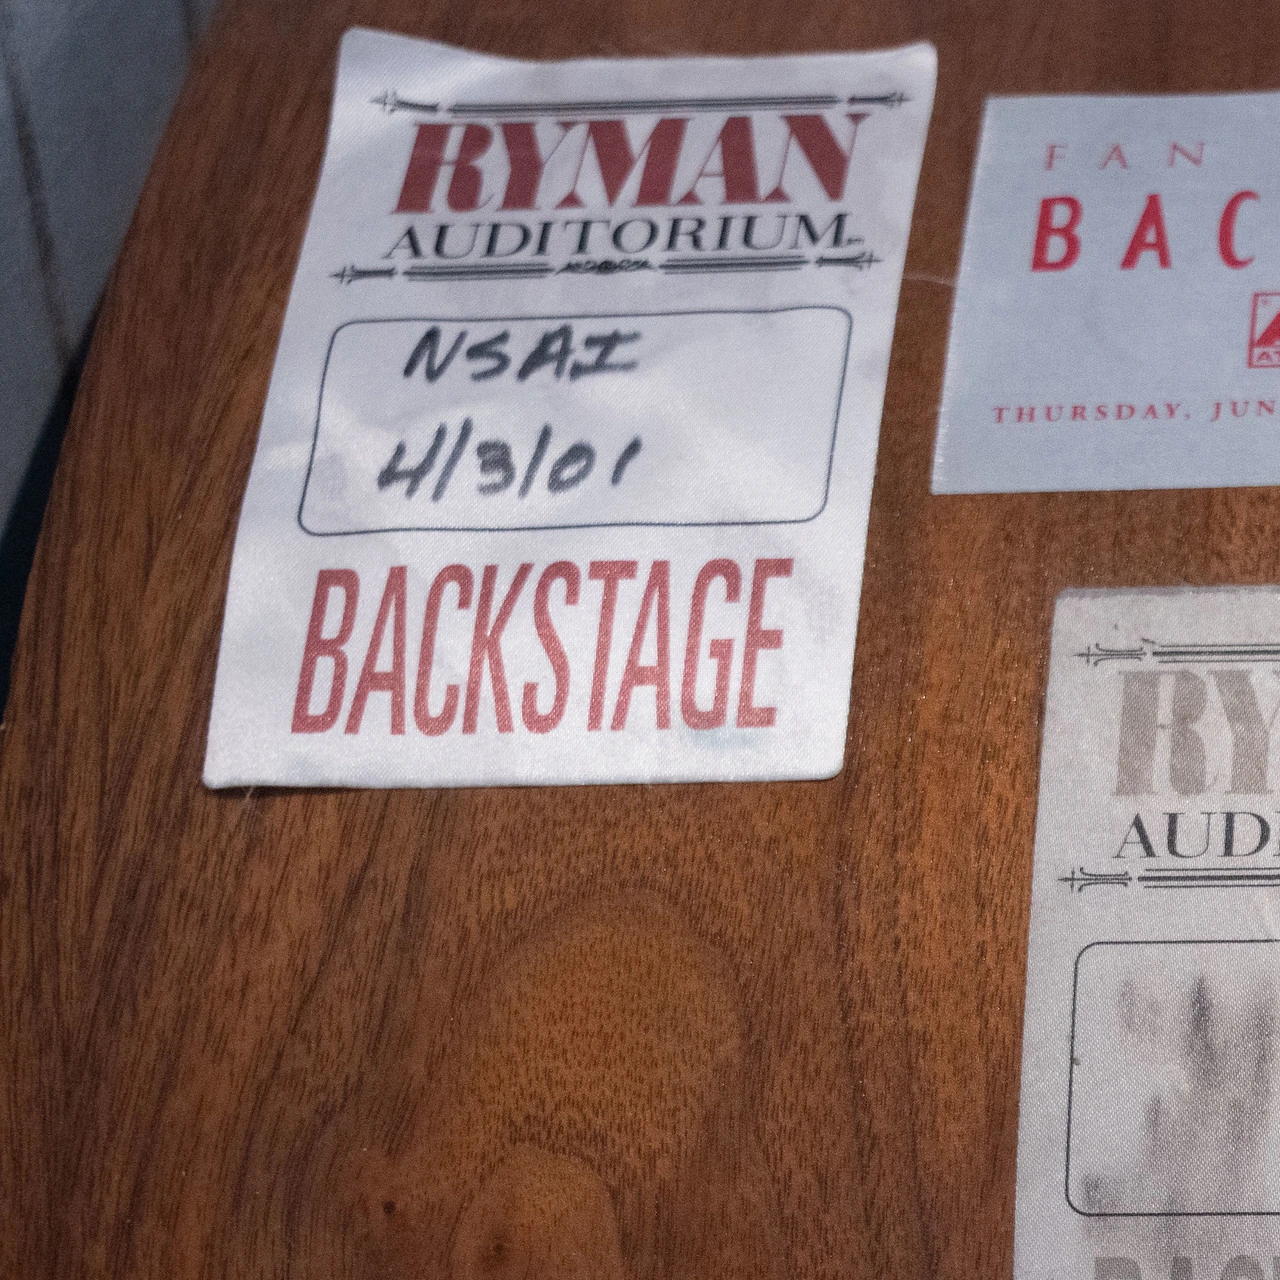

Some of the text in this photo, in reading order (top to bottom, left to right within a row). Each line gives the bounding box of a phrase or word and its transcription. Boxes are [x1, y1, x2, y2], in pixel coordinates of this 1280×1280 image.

[391, 110, 874, 214] RYMAN
[1044, 139, 1207, 171] FAN
[381, 212, 850, 260] AUDITORIUM
[403, 325, 642, 381] NSAI
[993, 403, 1190, 423] THURSDAY,
[376, 417, 643, 502] 4/3/01
[290, 558, 794, 736] BACKSTAGE
